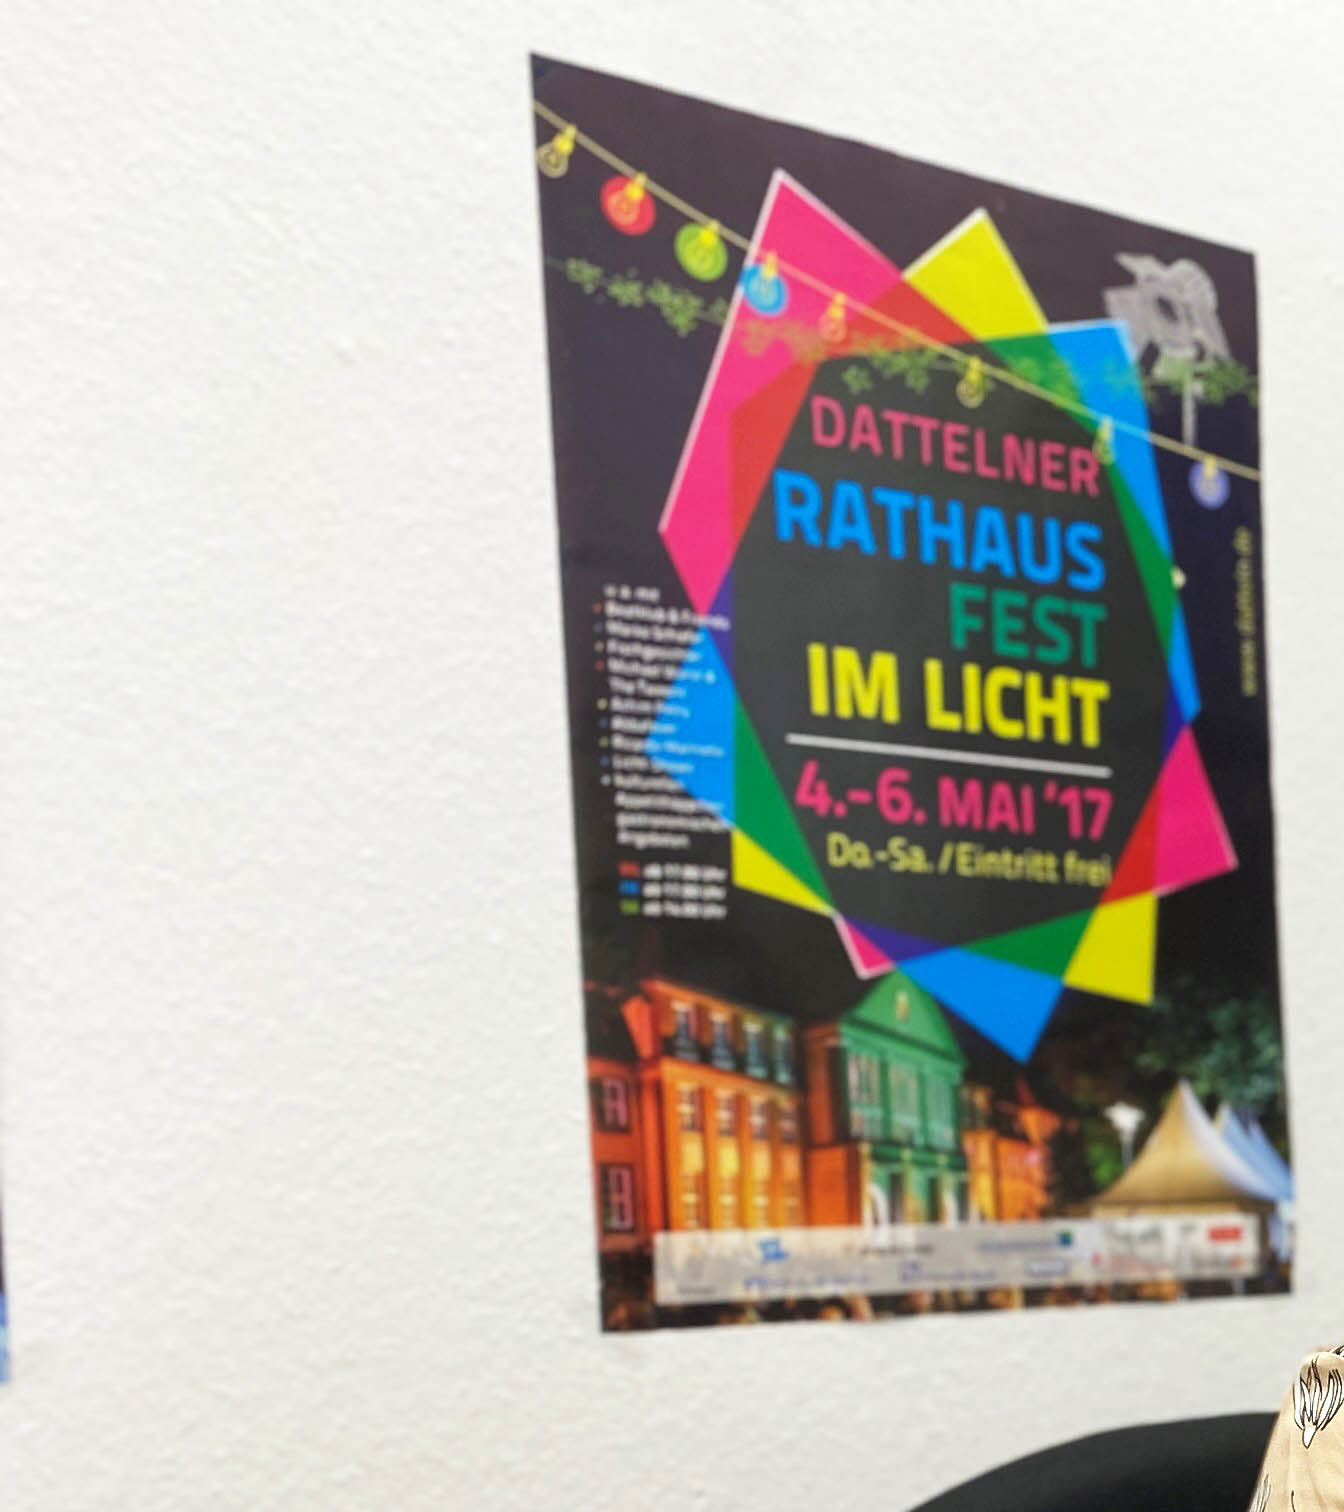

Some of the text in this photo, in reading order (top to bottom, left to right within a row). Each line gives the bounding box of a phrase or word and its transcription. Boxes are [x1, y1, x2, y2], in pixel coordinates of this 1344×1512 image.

[810, 394, 1100, 497] DATTELNER
[771, 468, 1107, 593] RATHAUS
[949, 580, 1108, 669] FEST
[807, 641, 1111, 749] IM LICHT
[794, 759, 928, 826] 4.-6.
[938, 776, 1035, 836] MAI
[1064, 849, 1112, 888] frei
